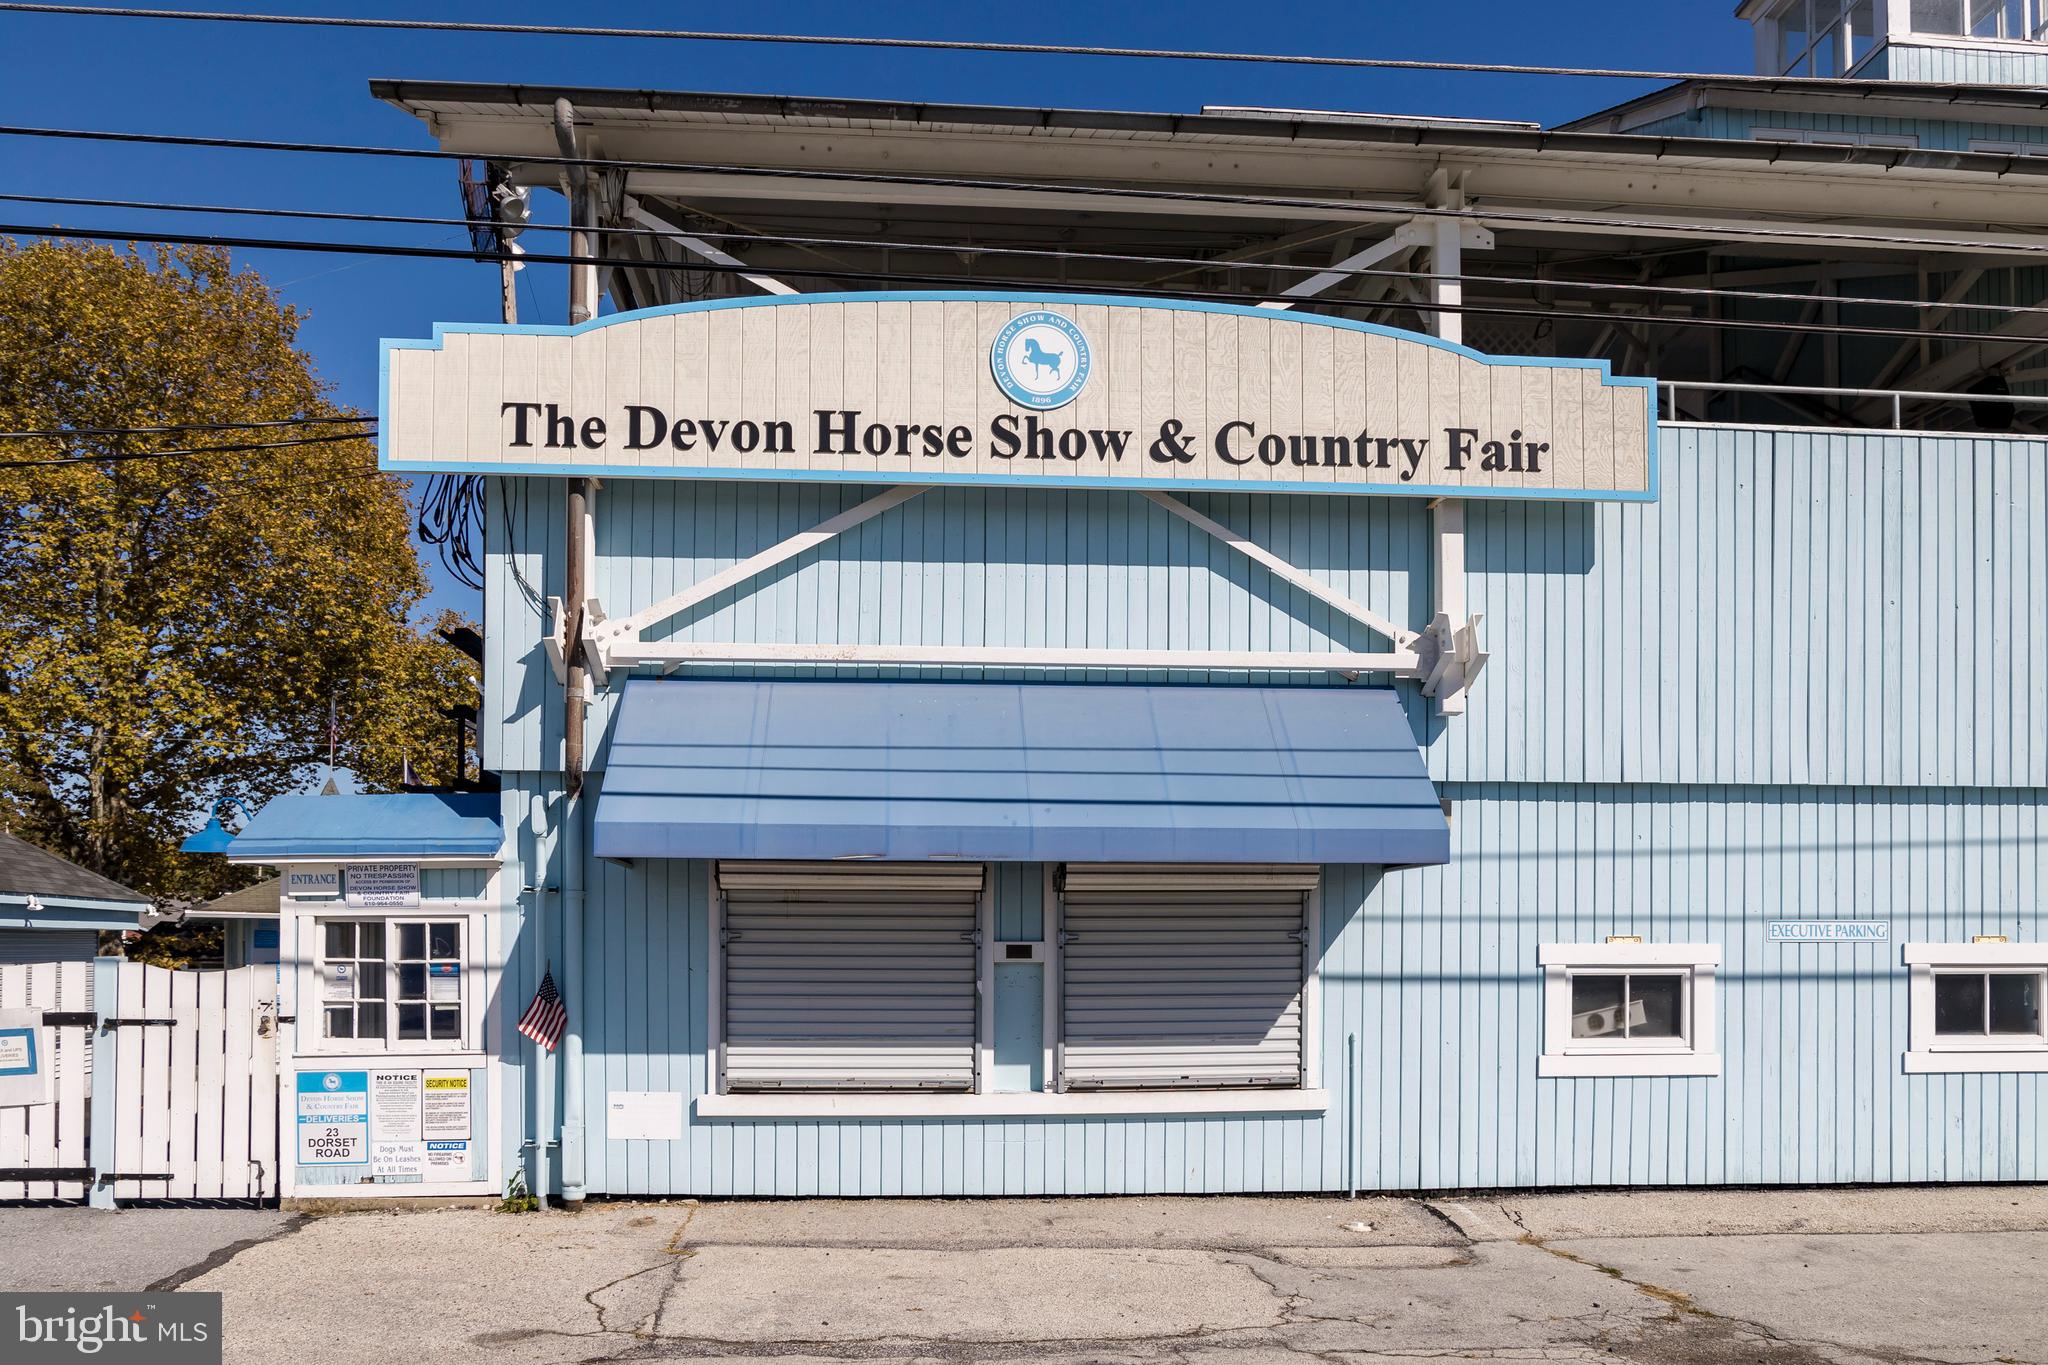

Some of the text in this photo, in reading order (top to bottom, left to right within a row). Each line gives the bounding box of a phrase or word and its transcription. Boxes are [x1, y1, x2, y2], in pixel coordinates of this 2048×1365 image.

[997, 315, 1088, 392] DEVON HORSE SHOW AND COUNTRY FAIR
[501, 402, 1551, 482] The Devon Horse Show & Country Fair
[379, 864, 417, 872] PROPERTY
[291, 874, 336, 884] ENTRANCE
[1771, 924, 1886, 938] EXECUTIVE PARKING
[425, 1079, 467, 1088] SECURITY NOTICE
[305, 1114, 360, 1123] DELIVERIES
[326, 1127, 339, 1137] 23
[308, 1137, 357, 1148] DORSET
[429, 1142, 465, 1150] NOTICE
[315, 1148, 350, 1158] ROAD
[379, 1145, 414, 1154] Dogs Must
[395, 1155, 421, 1163] Leashes
[386, 1165, 396, 1173] All
[397, 1165, 418, 1173] Times
